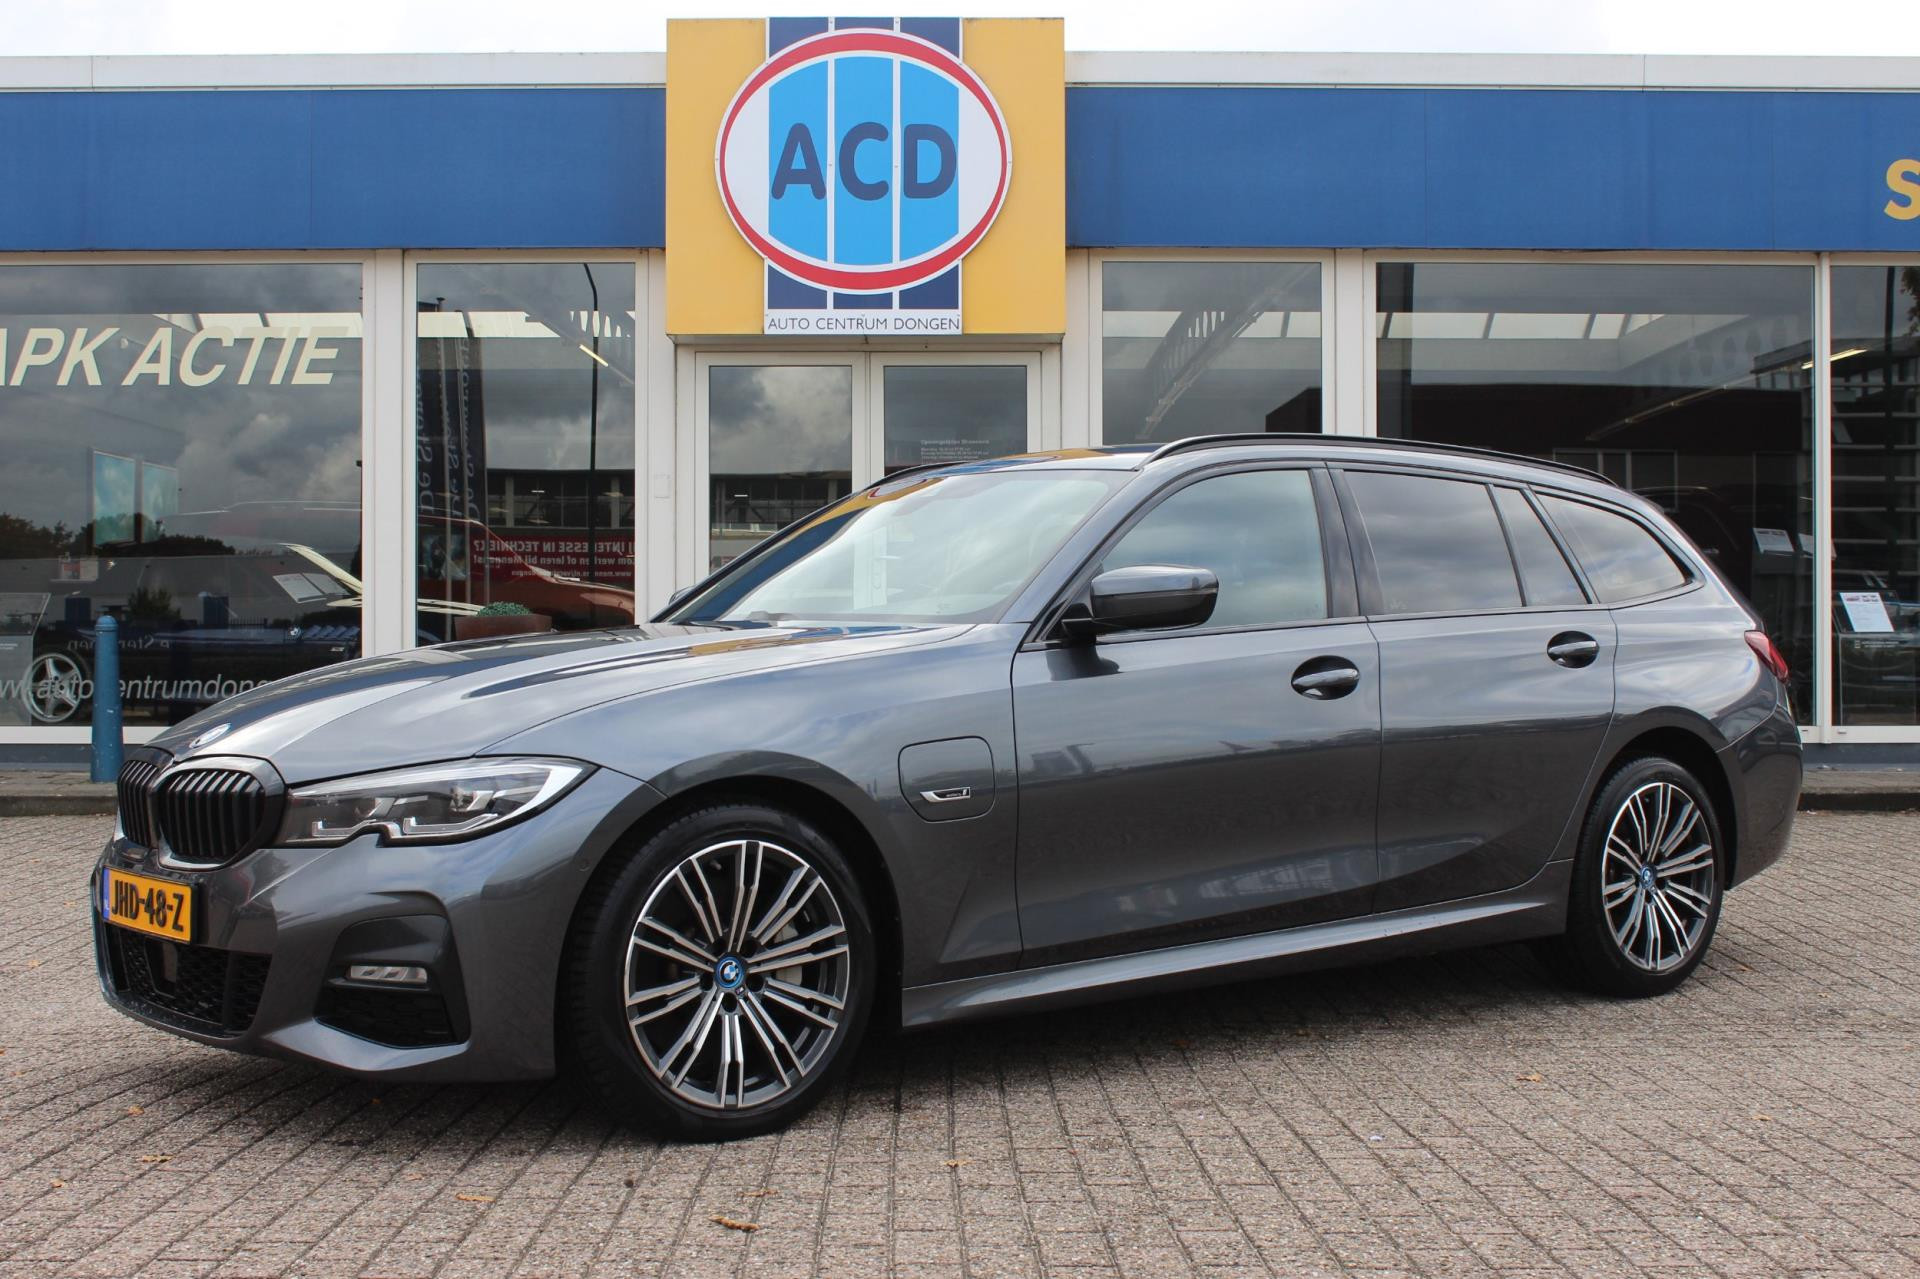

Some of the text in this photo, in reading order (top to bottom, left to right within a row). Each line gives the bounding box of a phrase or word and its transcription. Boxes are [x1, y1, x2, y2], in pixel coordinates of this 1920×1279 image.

[771, 121, 957, 201] ACD
[768, 317, 960, 330] AUTO CENTRUM DONGEN
[0, 326, 350, 387] PK ACTIE
[112, 880, 184, 932] JHD-48-Z
